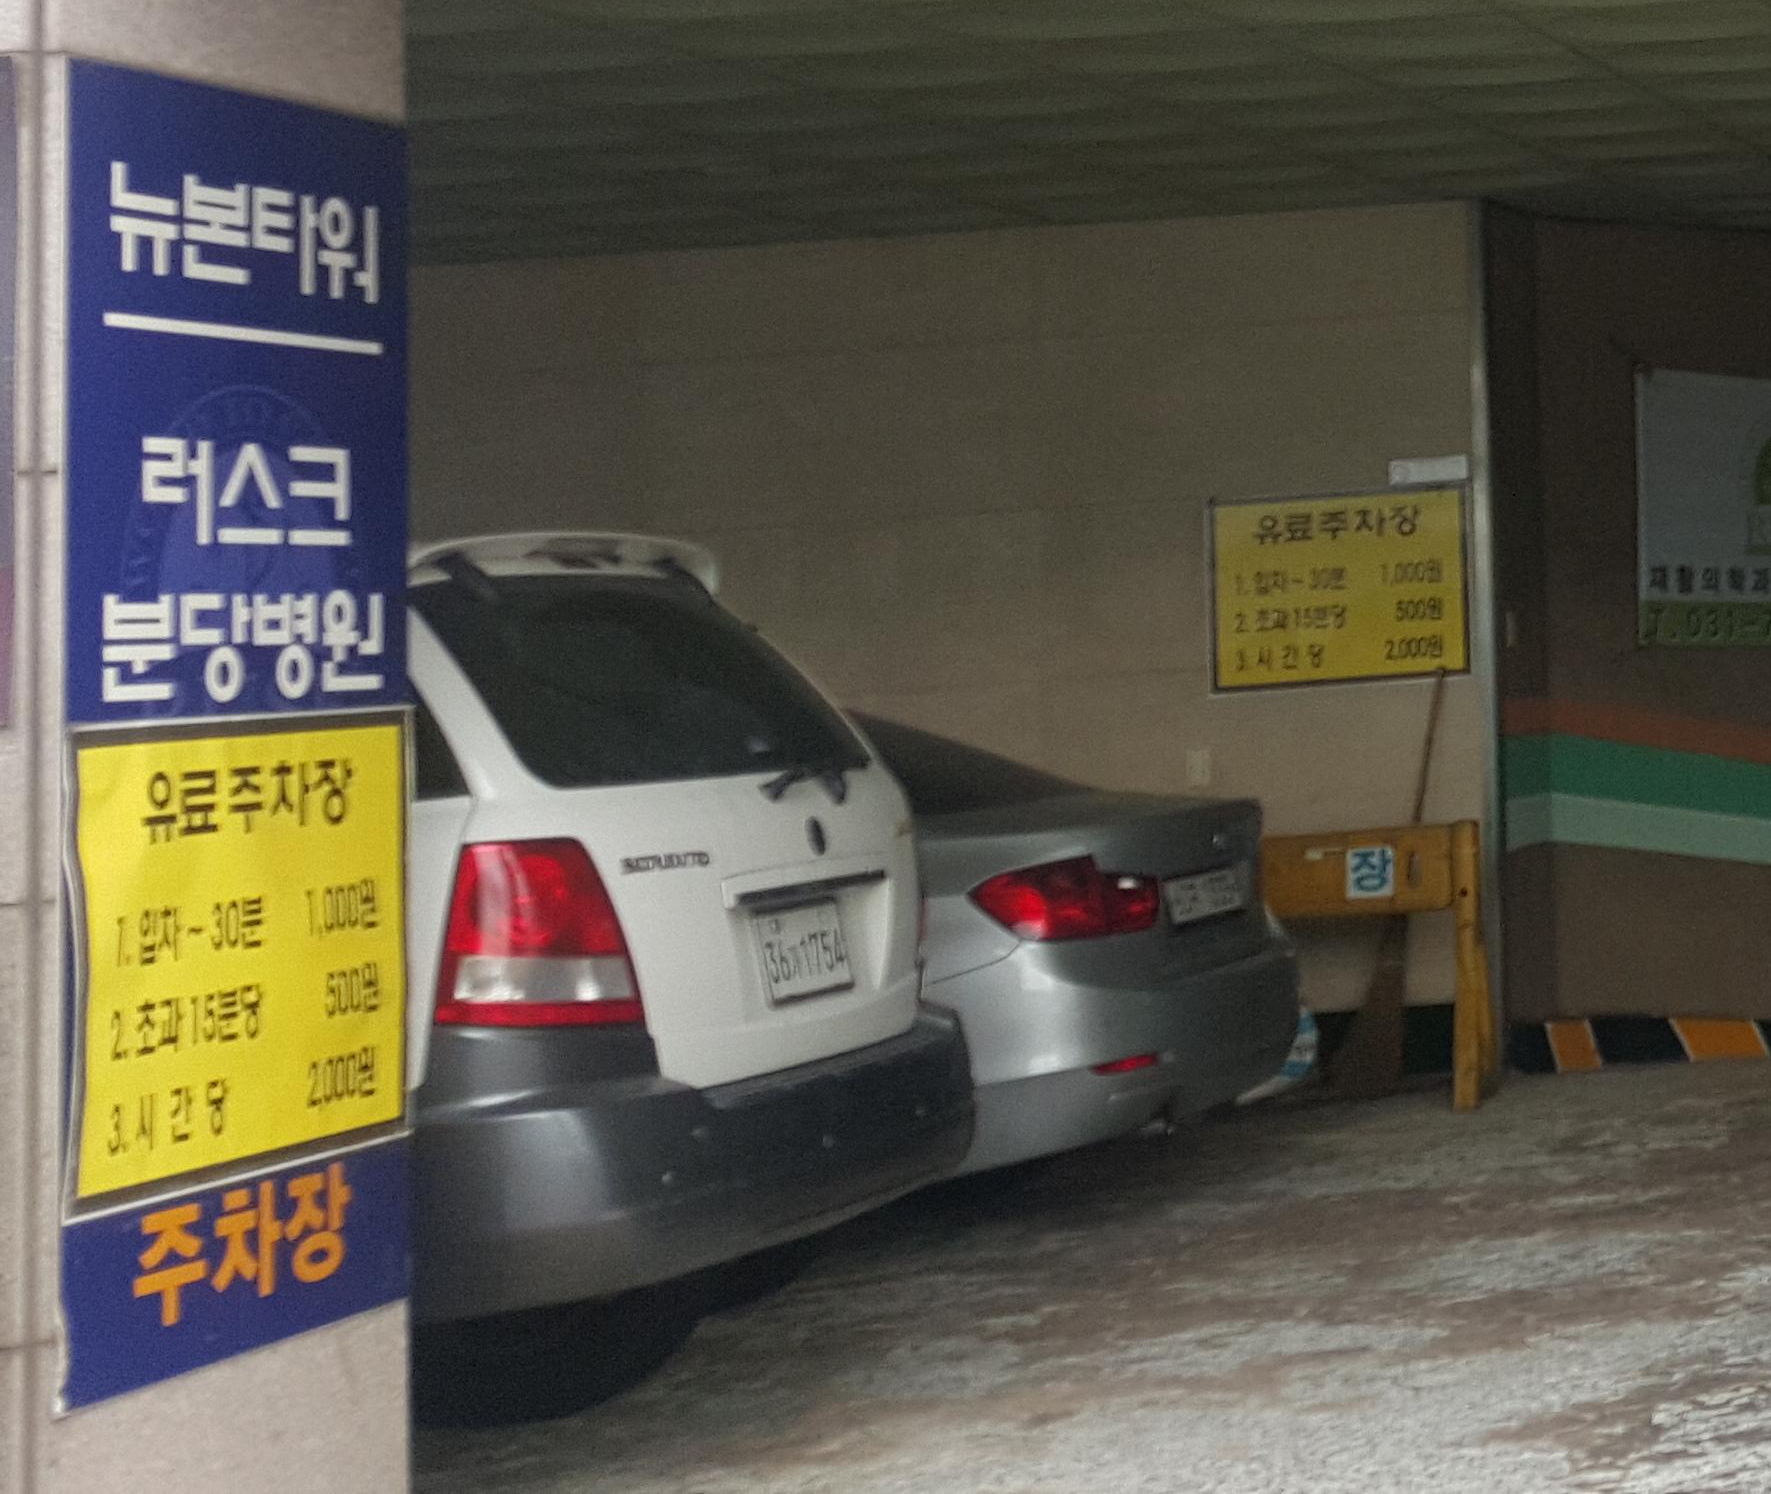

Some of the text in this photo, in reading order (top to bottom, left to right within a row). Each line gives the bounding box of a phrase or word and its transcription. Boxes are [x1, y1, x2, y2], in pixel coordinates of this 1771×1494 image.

[109, 161, 381, 305] 뉴본타워
[141, 436, 352, 545] 러스크
[102, 589, 385, 703] 분당병원
[142, 757, 352, 844] 유료주차장
[327, 962, 379, 1018] 500원
[132, 1162, 351, 1327] 주차장
